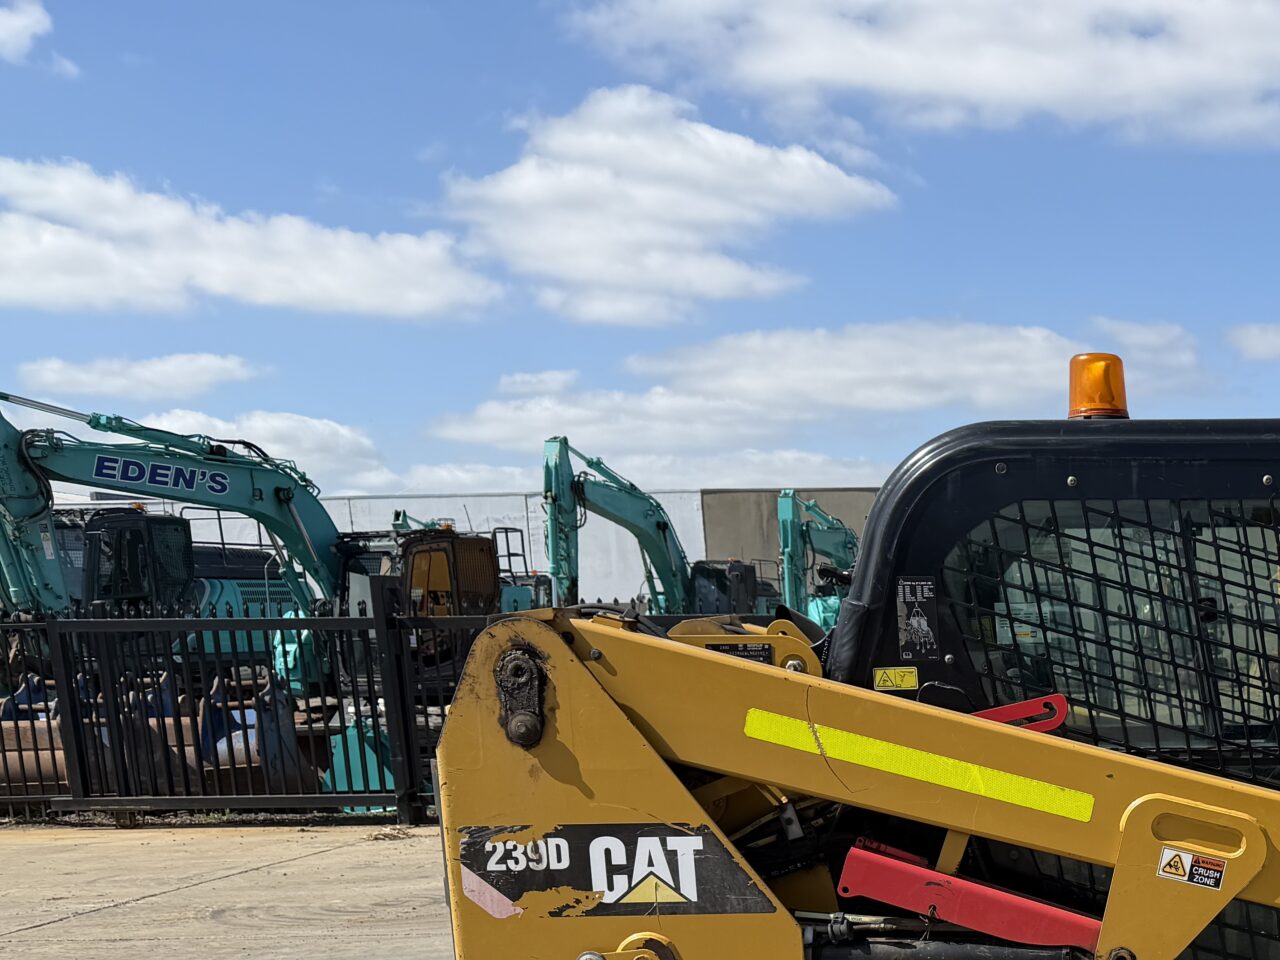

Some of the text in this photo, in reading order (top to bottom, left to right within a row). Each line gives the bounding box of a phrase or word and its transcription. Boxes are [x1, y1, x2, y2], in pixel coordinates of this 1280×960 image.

[93, 454, 230, 495] EDEN'S
[485, 836, 703, 904] 239D CAT
[1192, 866, 1220, 879] CRUSH
[1193, 874, 1216, 886] ZONE
